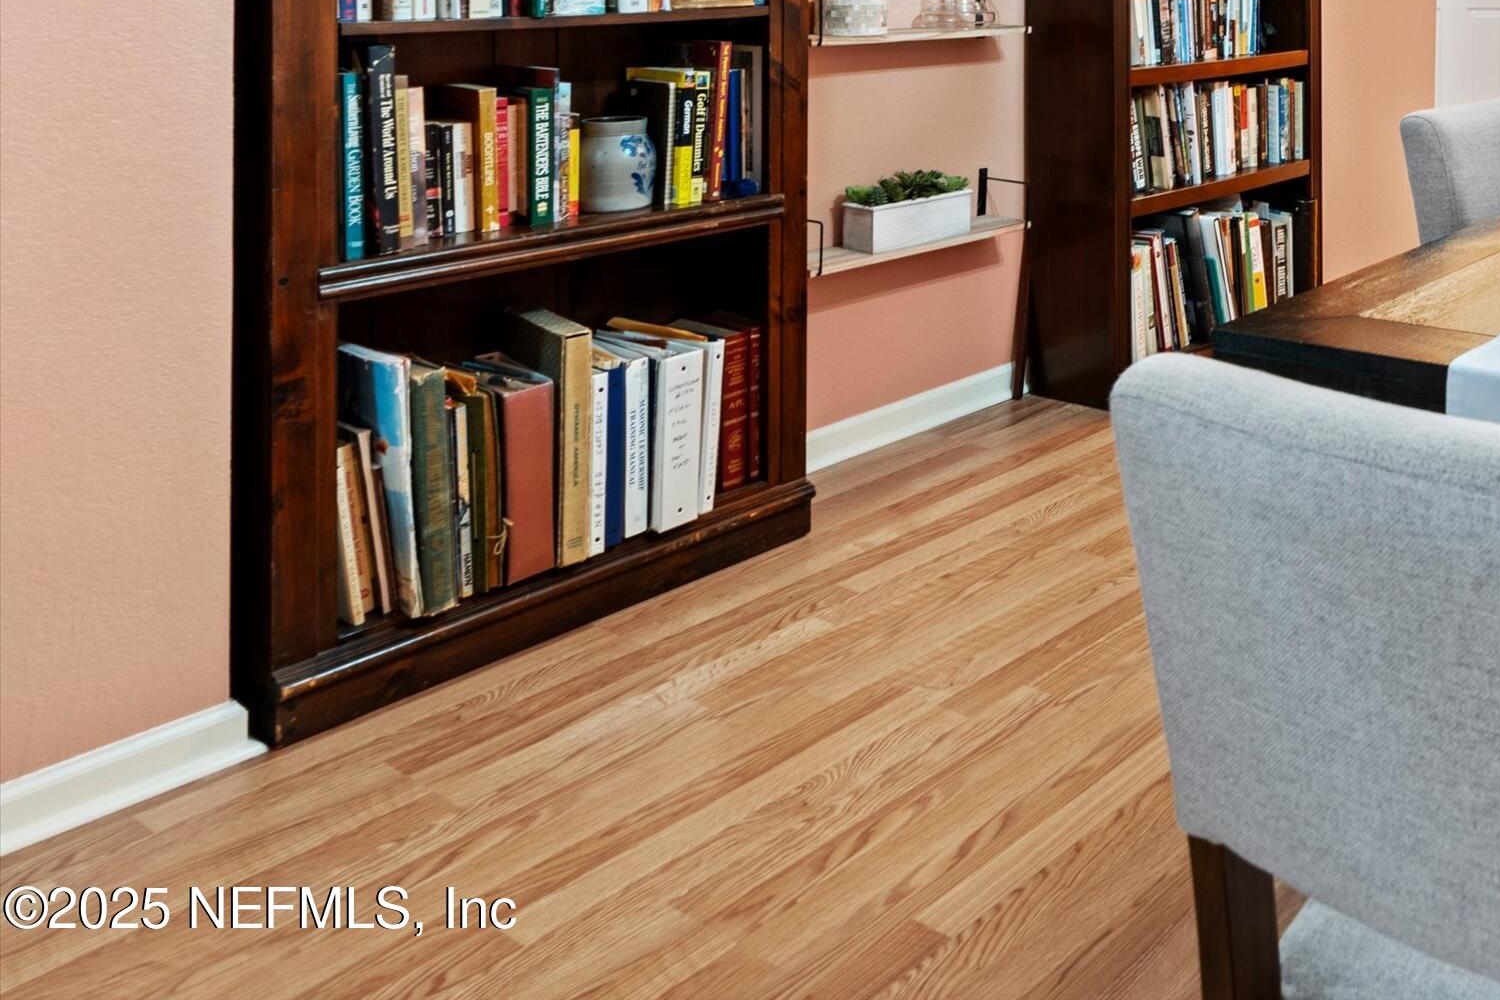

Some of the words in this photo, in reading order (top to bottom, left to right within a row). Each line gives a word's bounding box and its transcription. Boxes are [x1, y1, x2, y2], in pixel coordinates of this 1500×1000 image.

[380, 98, 394, 118] The
[534, 102, 550, 122] THE
[682, 99, 694, 135] German
[695, 93, 707, 117] Golf
[381, 118, 395, 148] World
[692, 124, 705, 173] Dummies
[347, 149, 361, 193] GARDEN
[383, 150, 396, 184] Around
[1135, 157, 1145, 181] WAR
[384, 186, 397, 200] Us
[534, 176, 550, 201] BIBLE
[348, 195, 361, 227] BOOK
[629, 409, 637, 451] TRAINING
[638, 399, 647, 438] MASONIC
[629, 452, 637, 488] MANUAL
[638, 439, 646, 491] LEADERSHIP
[463, 553, 473, 586] HAMLYN
